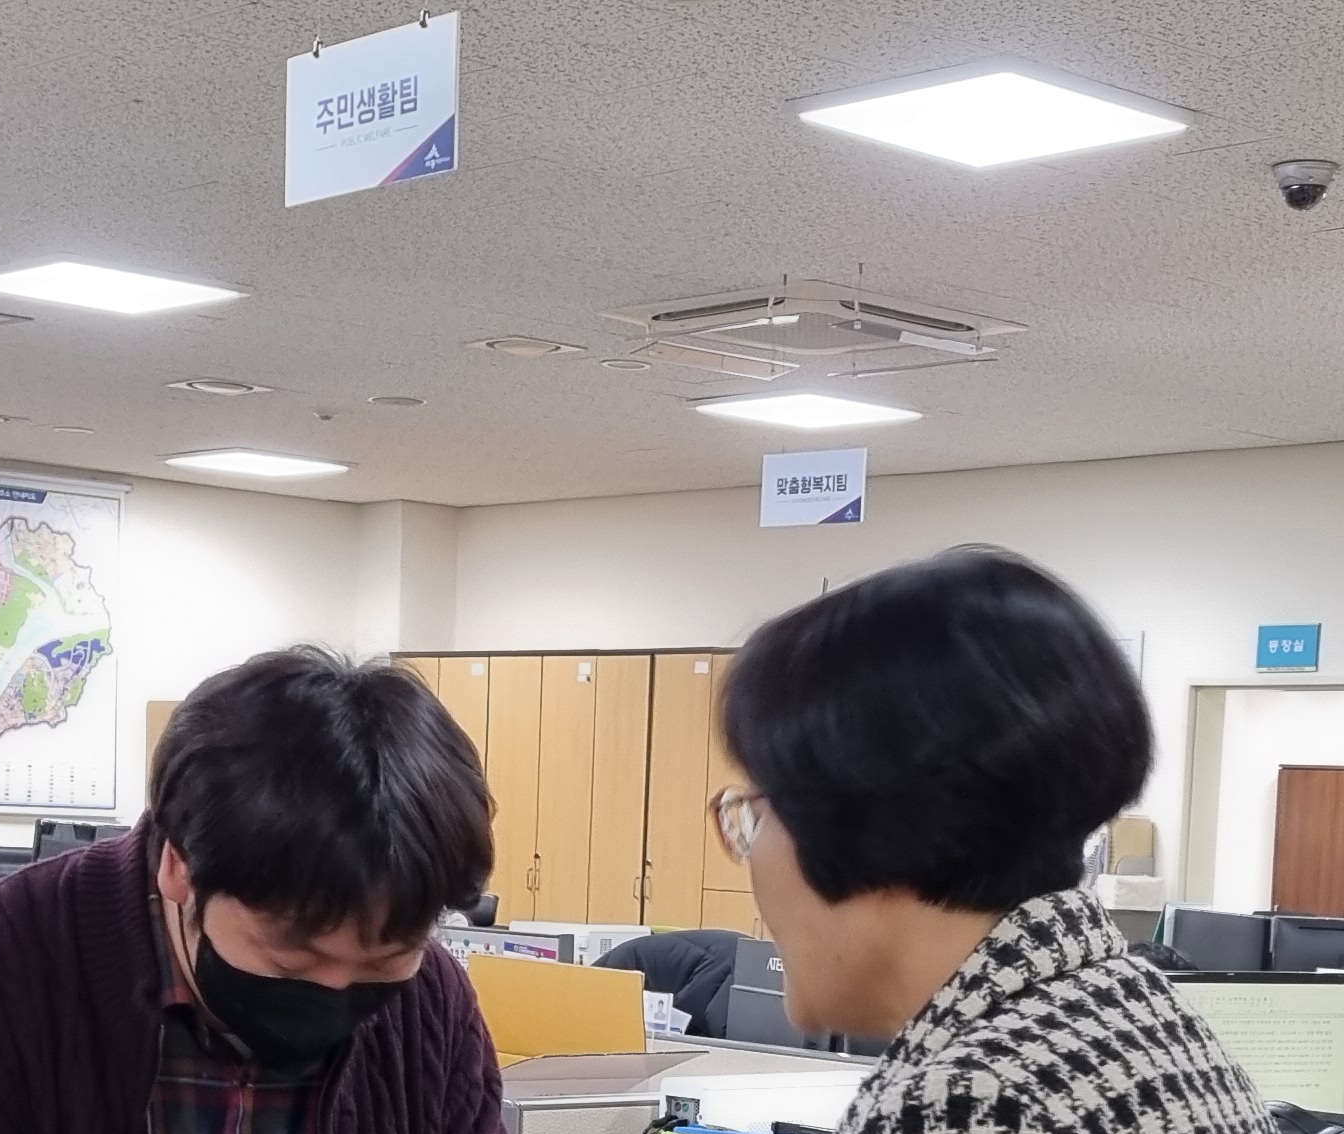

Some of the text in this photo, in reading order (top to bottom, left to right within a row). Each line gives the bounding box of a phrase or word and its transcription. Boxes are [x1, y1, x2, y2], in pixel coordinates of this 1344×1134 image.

[316, 75, 418, 135] 주민생활팀
[340, 127, 391, 148] PUBLIC WELFARE
[777, 474, 848, 495] 맞춤형복지팀
[1268, 639, 1304, 653] 동장실
